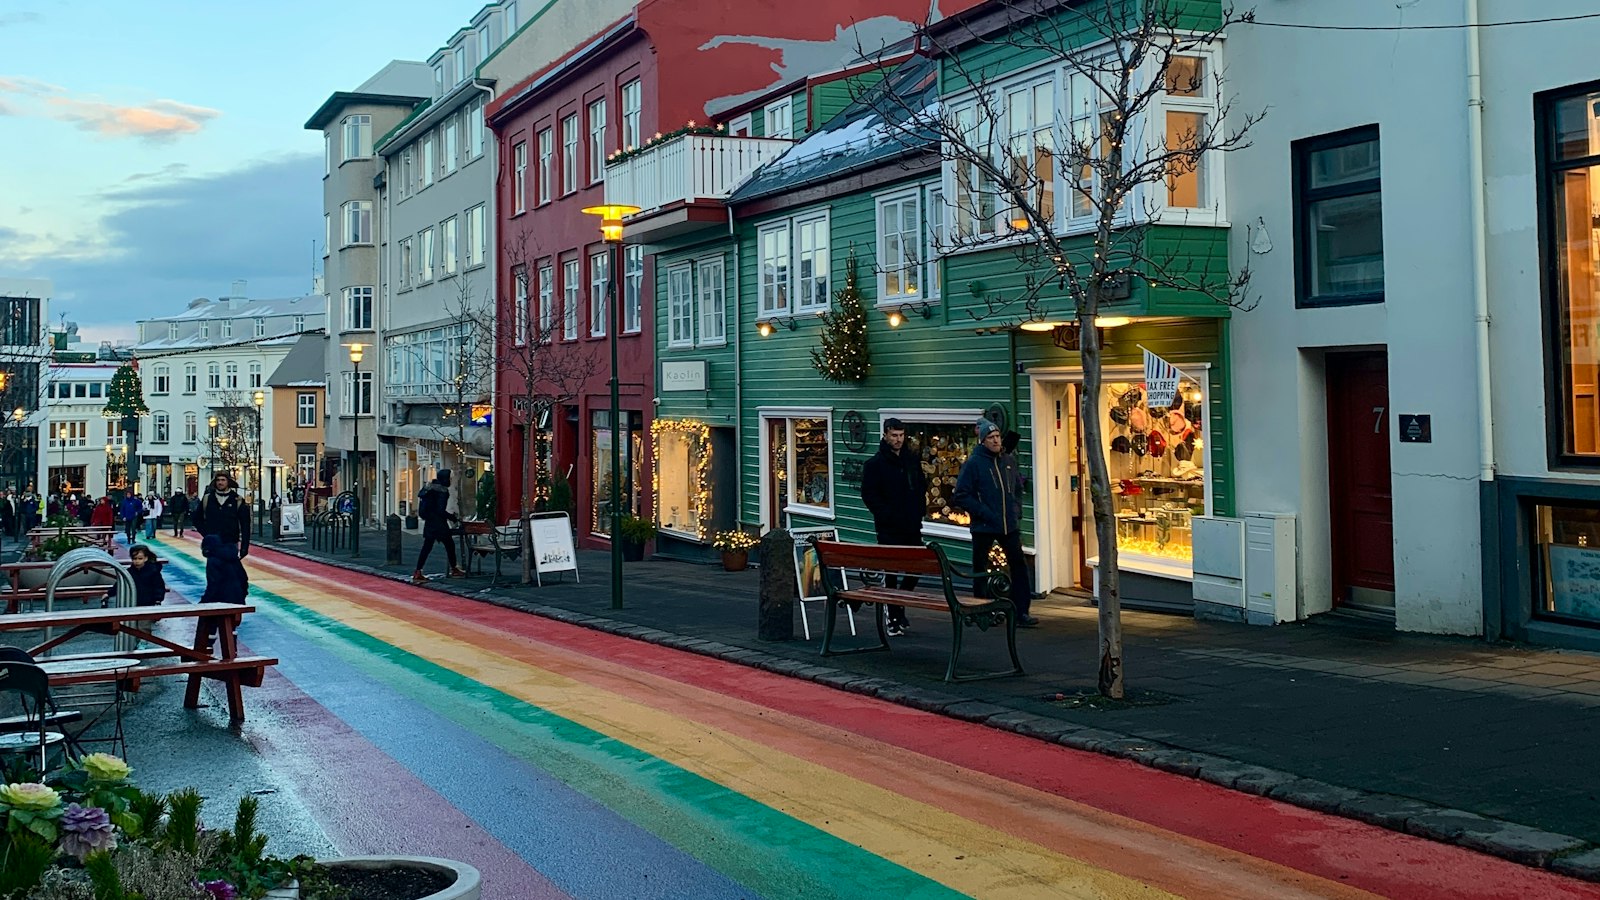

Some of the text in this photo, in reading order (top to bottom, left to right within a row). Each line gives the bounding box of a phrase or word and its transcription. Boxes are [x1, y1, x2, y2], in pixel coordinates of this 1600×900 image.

[666, 370, 701, 380] Kaolin
[1147, 381, 1175, 391] TAX FREE
[1147, 391, 1175, 400] SHOPPING
[1373, 407, 1384, 433] 7
